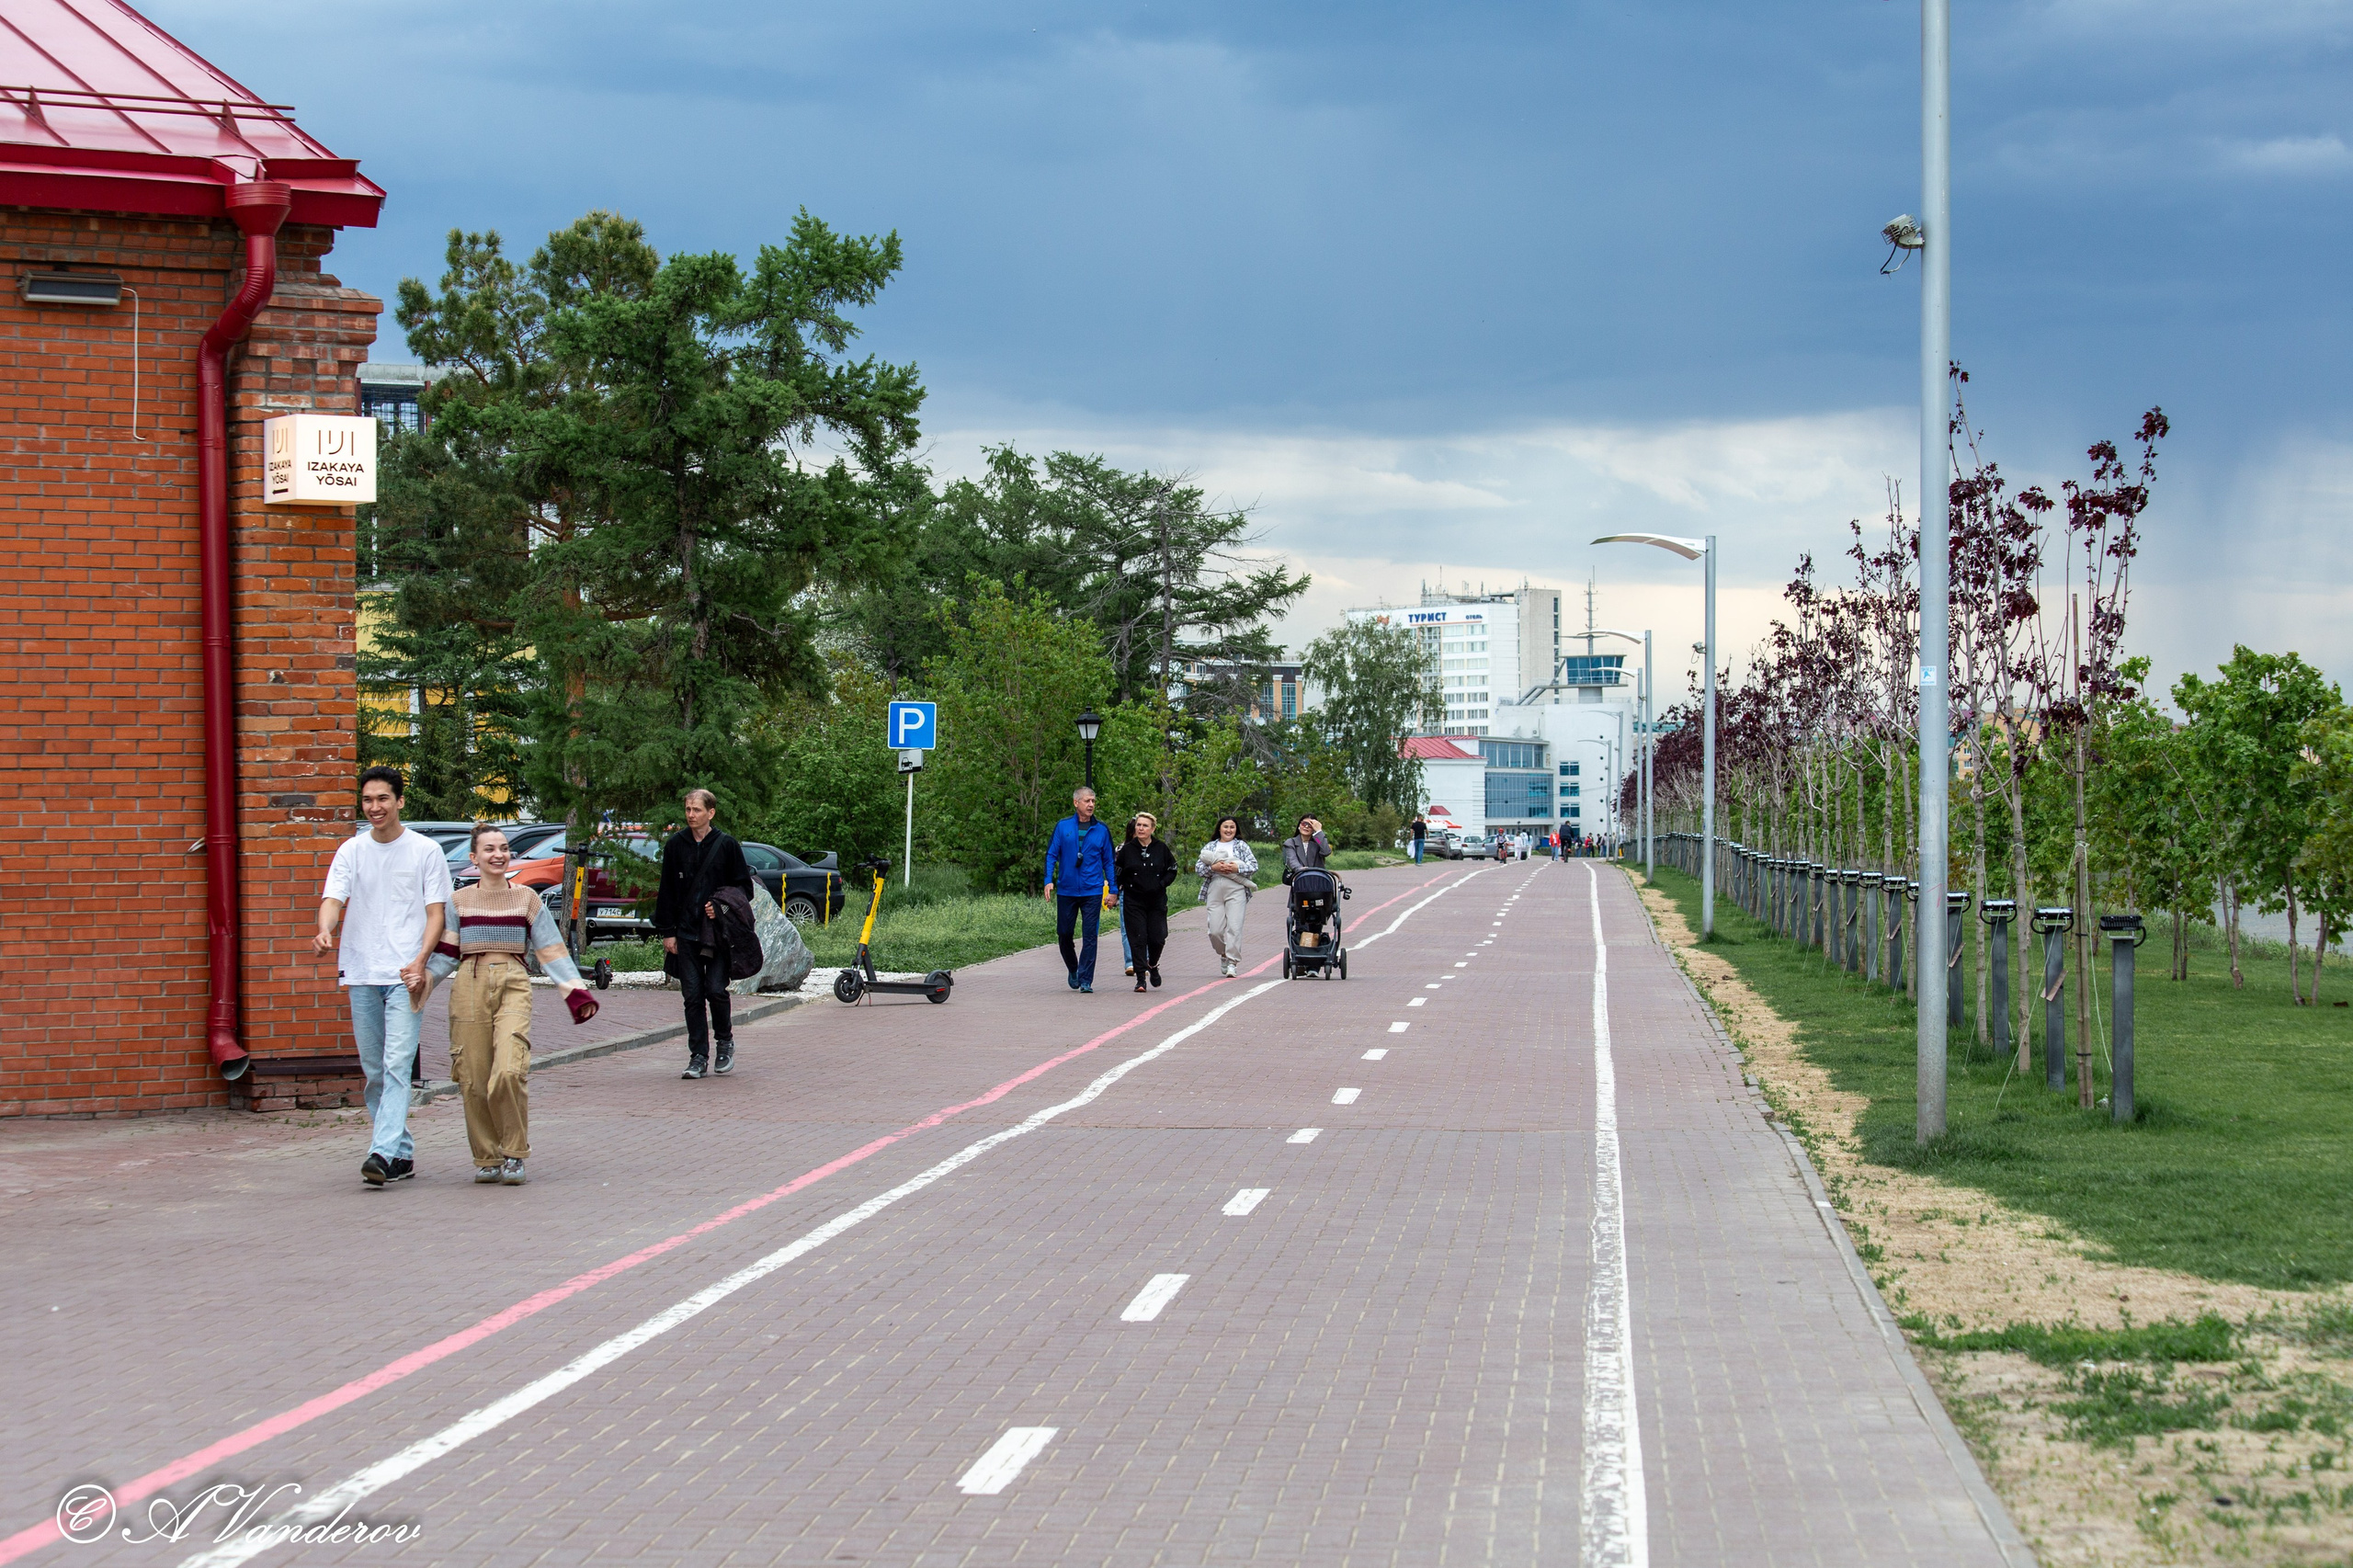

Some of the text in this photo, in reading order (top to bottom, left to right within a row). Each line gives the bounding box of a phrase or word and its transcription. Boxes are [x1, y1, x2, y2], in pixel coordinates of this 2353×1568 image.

[267, 459, 292, 472] IZAKAYA
[307, 461, 365, 473] IZAKAYA
[316, 473, 358, 487] YŌSAI
[1408, 612, 1447, 623] ТУРИСТ
[898, 707, 926, 744] P
